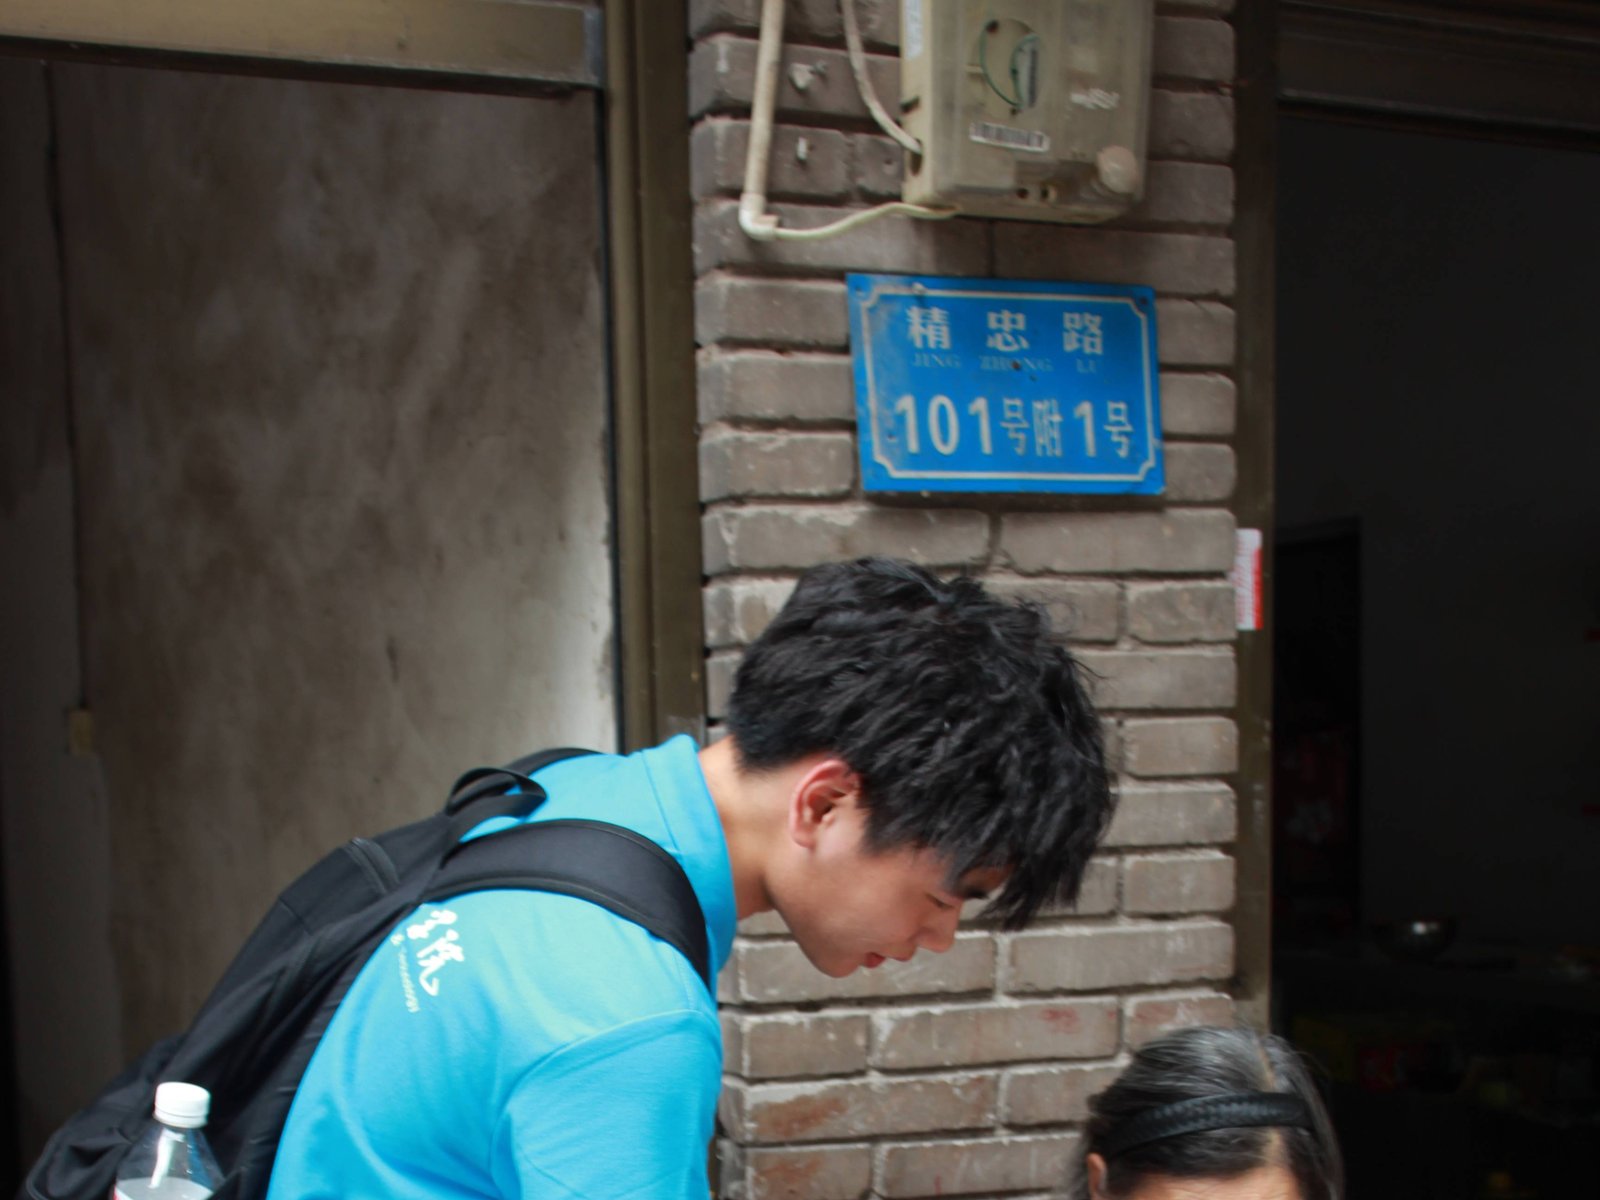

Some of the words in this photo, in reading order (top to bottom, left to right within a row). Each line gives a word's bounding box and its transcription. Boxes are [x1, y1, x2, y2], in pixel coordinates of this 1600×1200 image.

[906, 306, 1103, 354] 精忠路
[896, 394, 1133, 458] 101号附1号
